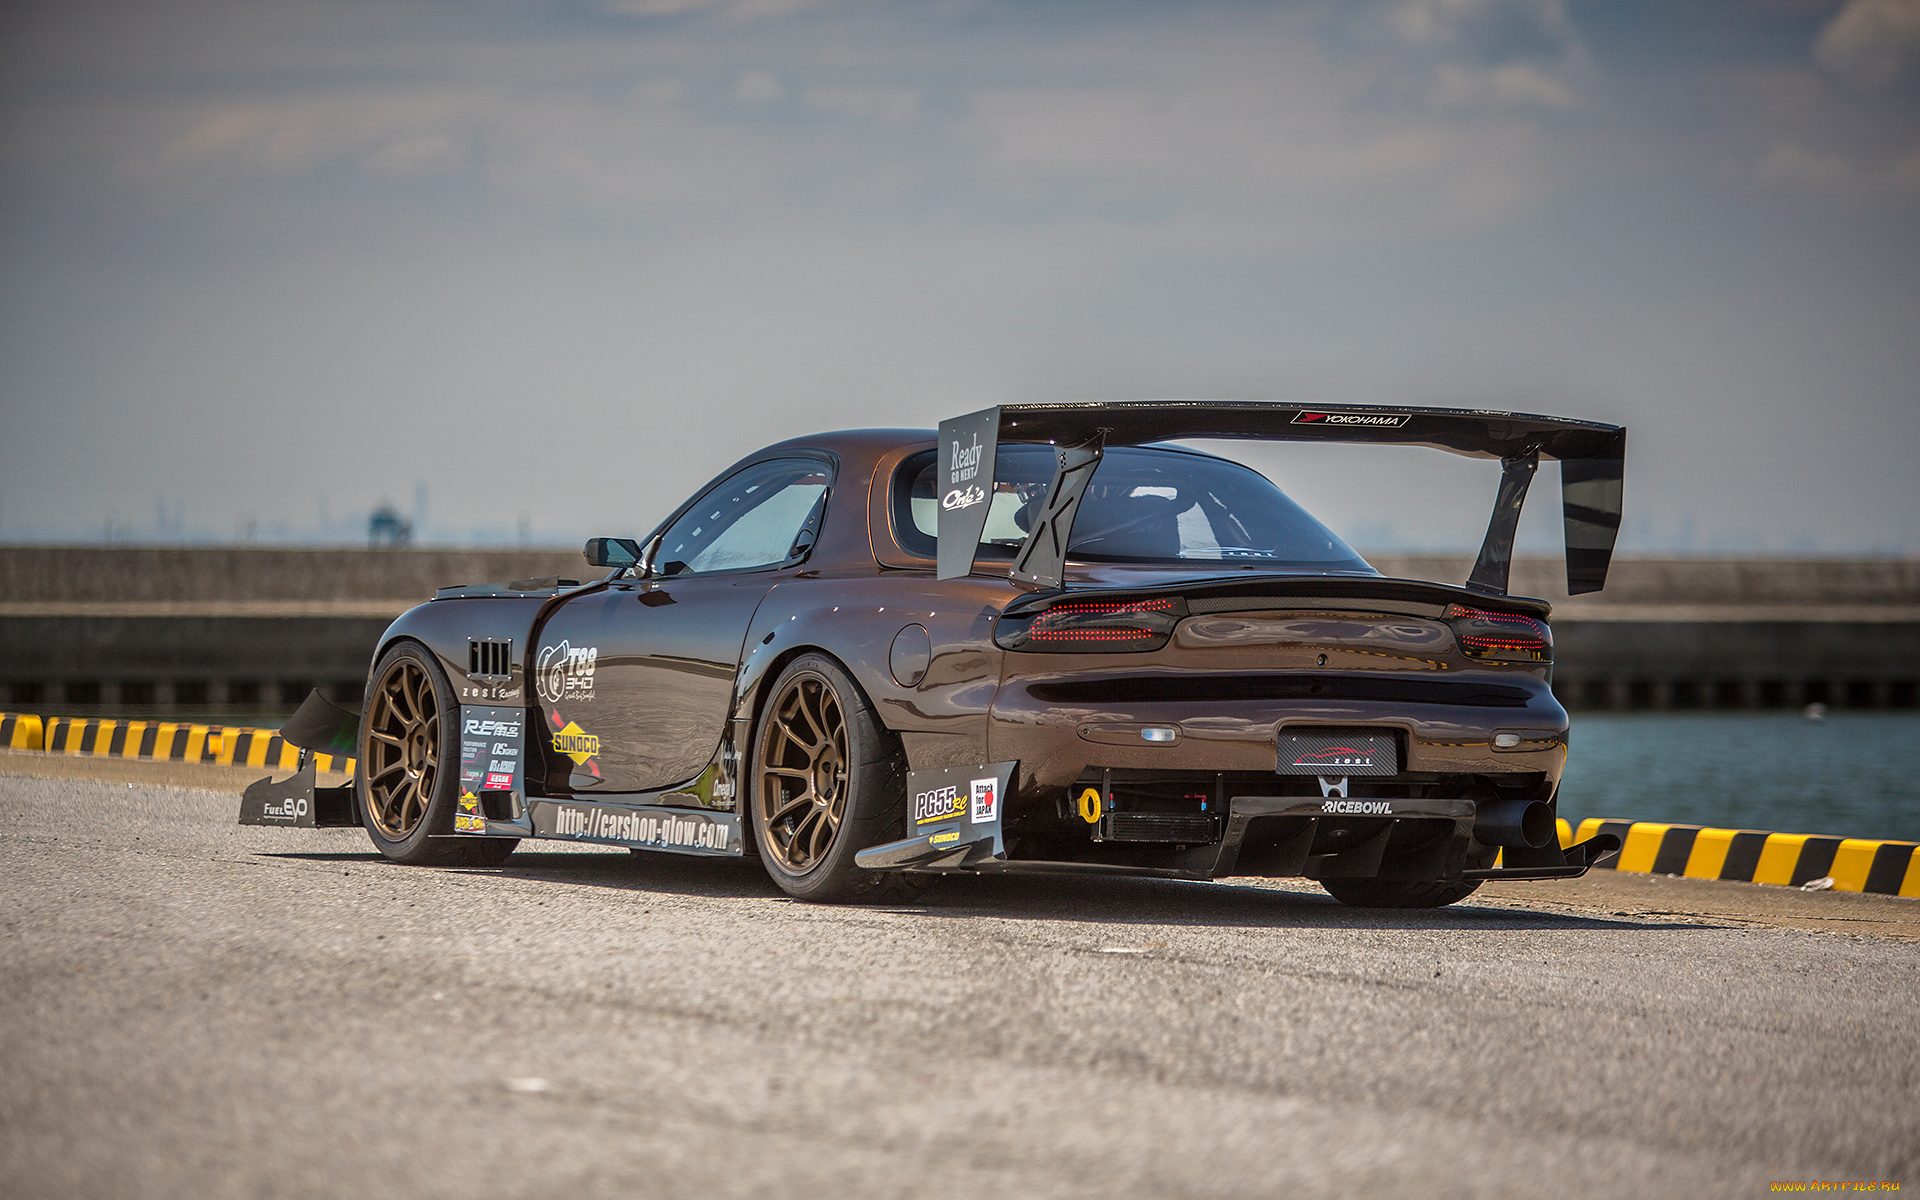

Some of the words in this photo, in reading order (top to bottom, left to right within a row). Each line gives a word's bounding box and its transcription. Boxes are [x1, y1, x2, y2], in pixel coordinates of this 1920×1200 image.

[1325, 415, 1399, 425] YOKOHAMA
[951, 432, 983, 477] Ready
[951, 471, 959, 484] GO
[961, 467, 975, 481] NEXT
[567, 647, 598, 676] T88
[463, 687, 497, 698] zest
[498, 689, 520, 699] Racing
[555, 734, 597, 754] SUNOCO
[975, 783, 993, 794] Attack
[915, 786, 957, 820] PG55
[952, 795, 968, 811] RC
[975, 795, 985, 805] for
[1321, 800, 1393, 814] RICEBOWL
[975, 805, 992, 815] JAPAN
[555, 806, 729, 850] http://carshop-glow.com
[933, 832, 959, 843] SUNOCO
